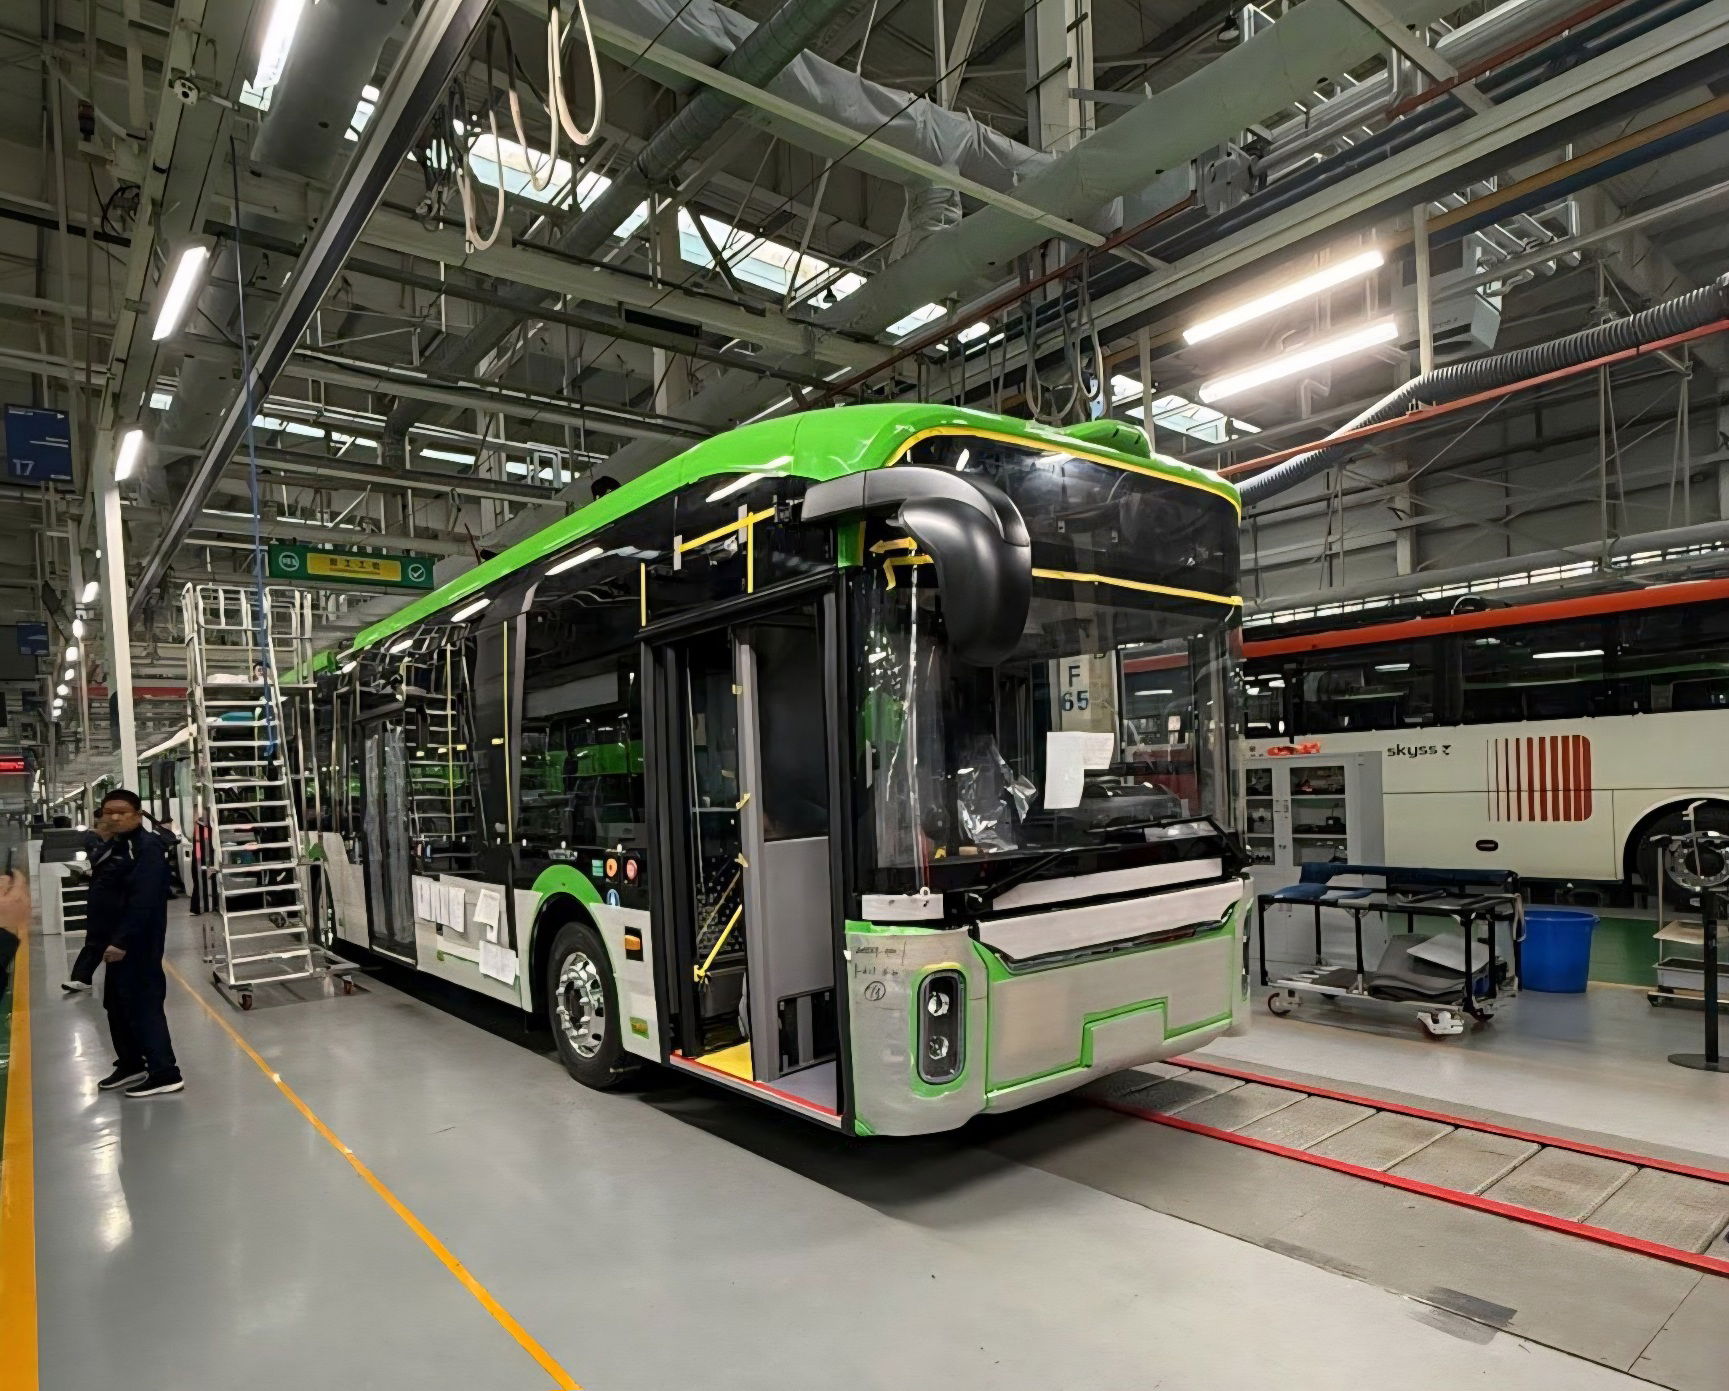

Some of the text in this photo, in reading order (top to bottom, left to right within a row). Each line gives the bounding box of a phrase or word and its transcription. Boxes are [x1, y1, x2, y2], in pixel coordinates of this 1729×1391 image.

[12, 459, 35, 476] 17
[1068, 665, 1081, 687] F
[1062, 690, 1089, 711] 65
[1387, 743, 1438, 758] skyss
